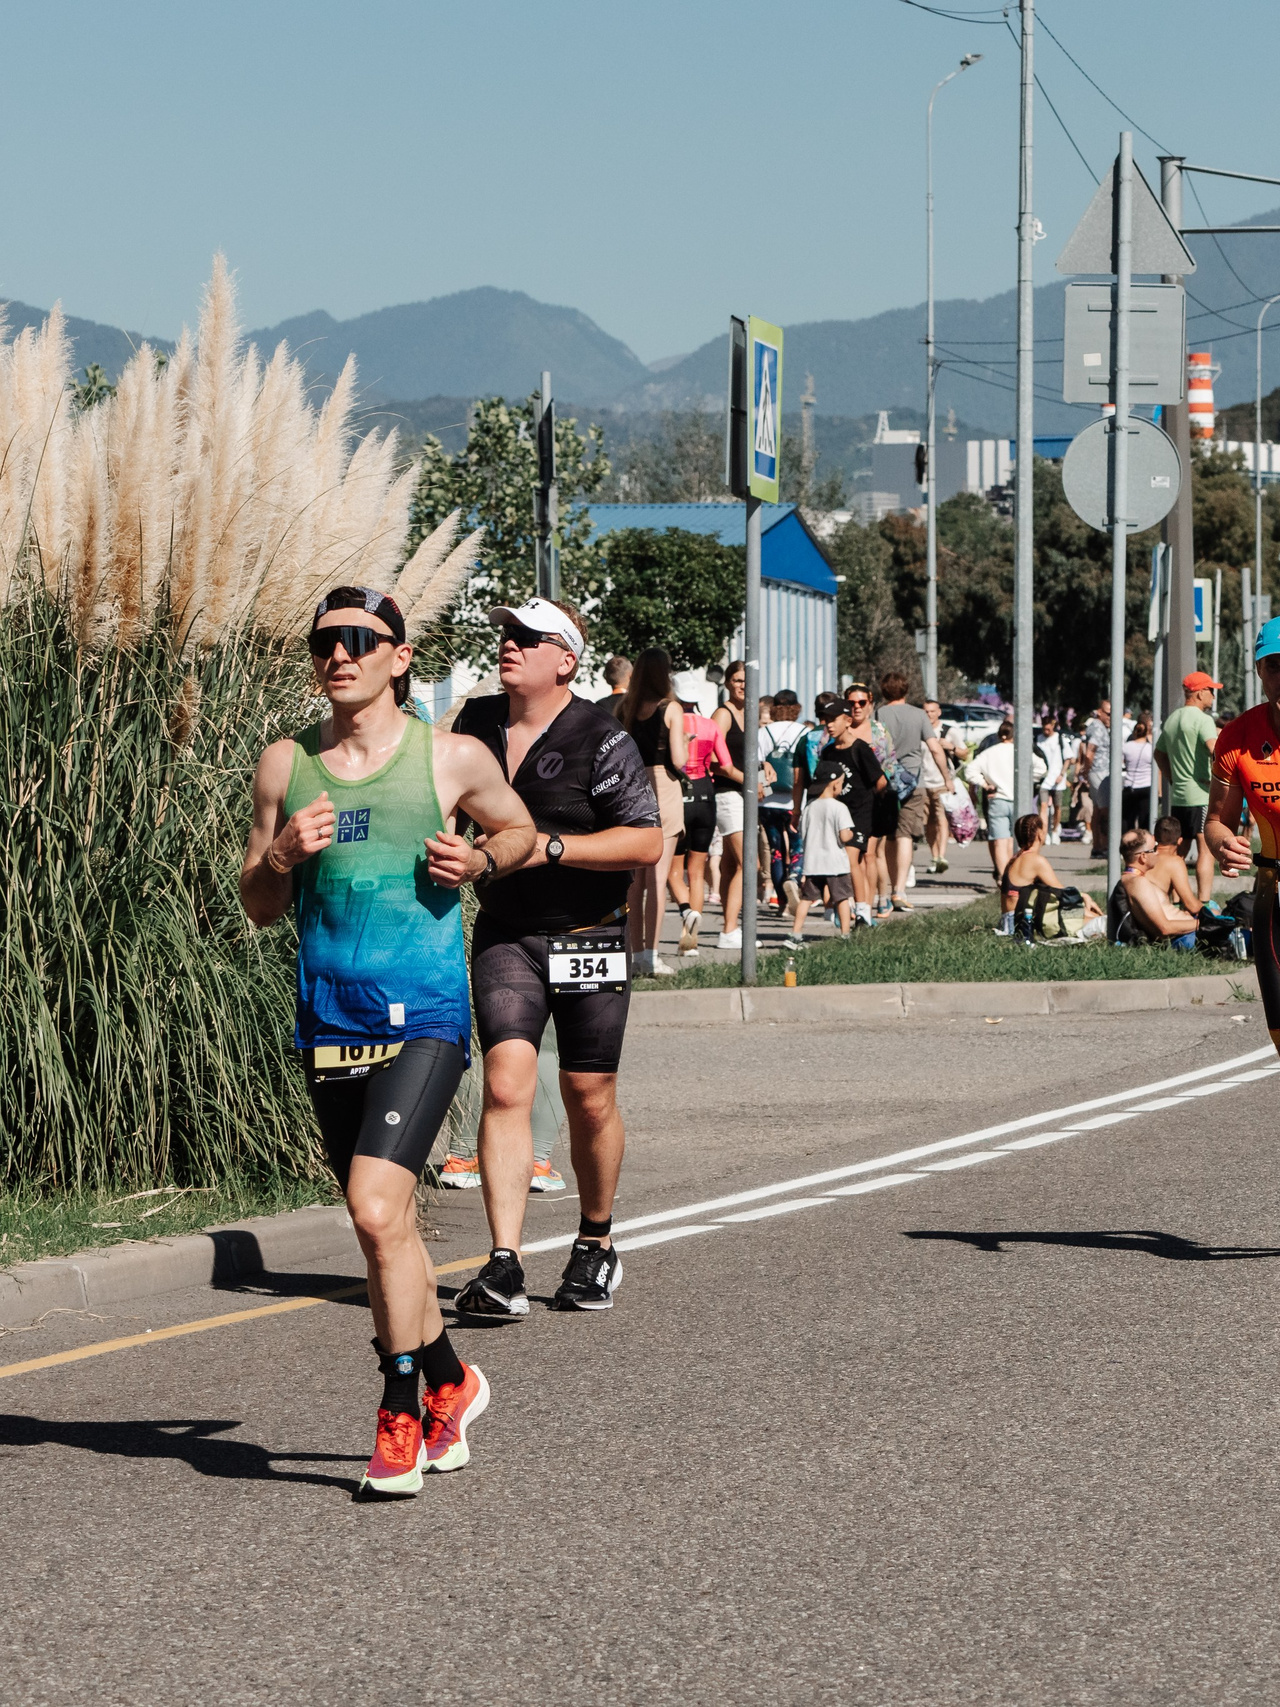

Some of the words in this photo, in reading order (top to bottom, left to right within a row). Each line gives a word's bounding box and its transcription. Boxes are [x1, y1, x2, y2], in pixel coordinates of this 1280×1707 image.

[569, 957, 609, 979] 354
[350, 1065, 371, 1075] АРТУР
[494, 1250, 511, 1258] HOKA
[595, 1260, 611, 1288] HOKA
